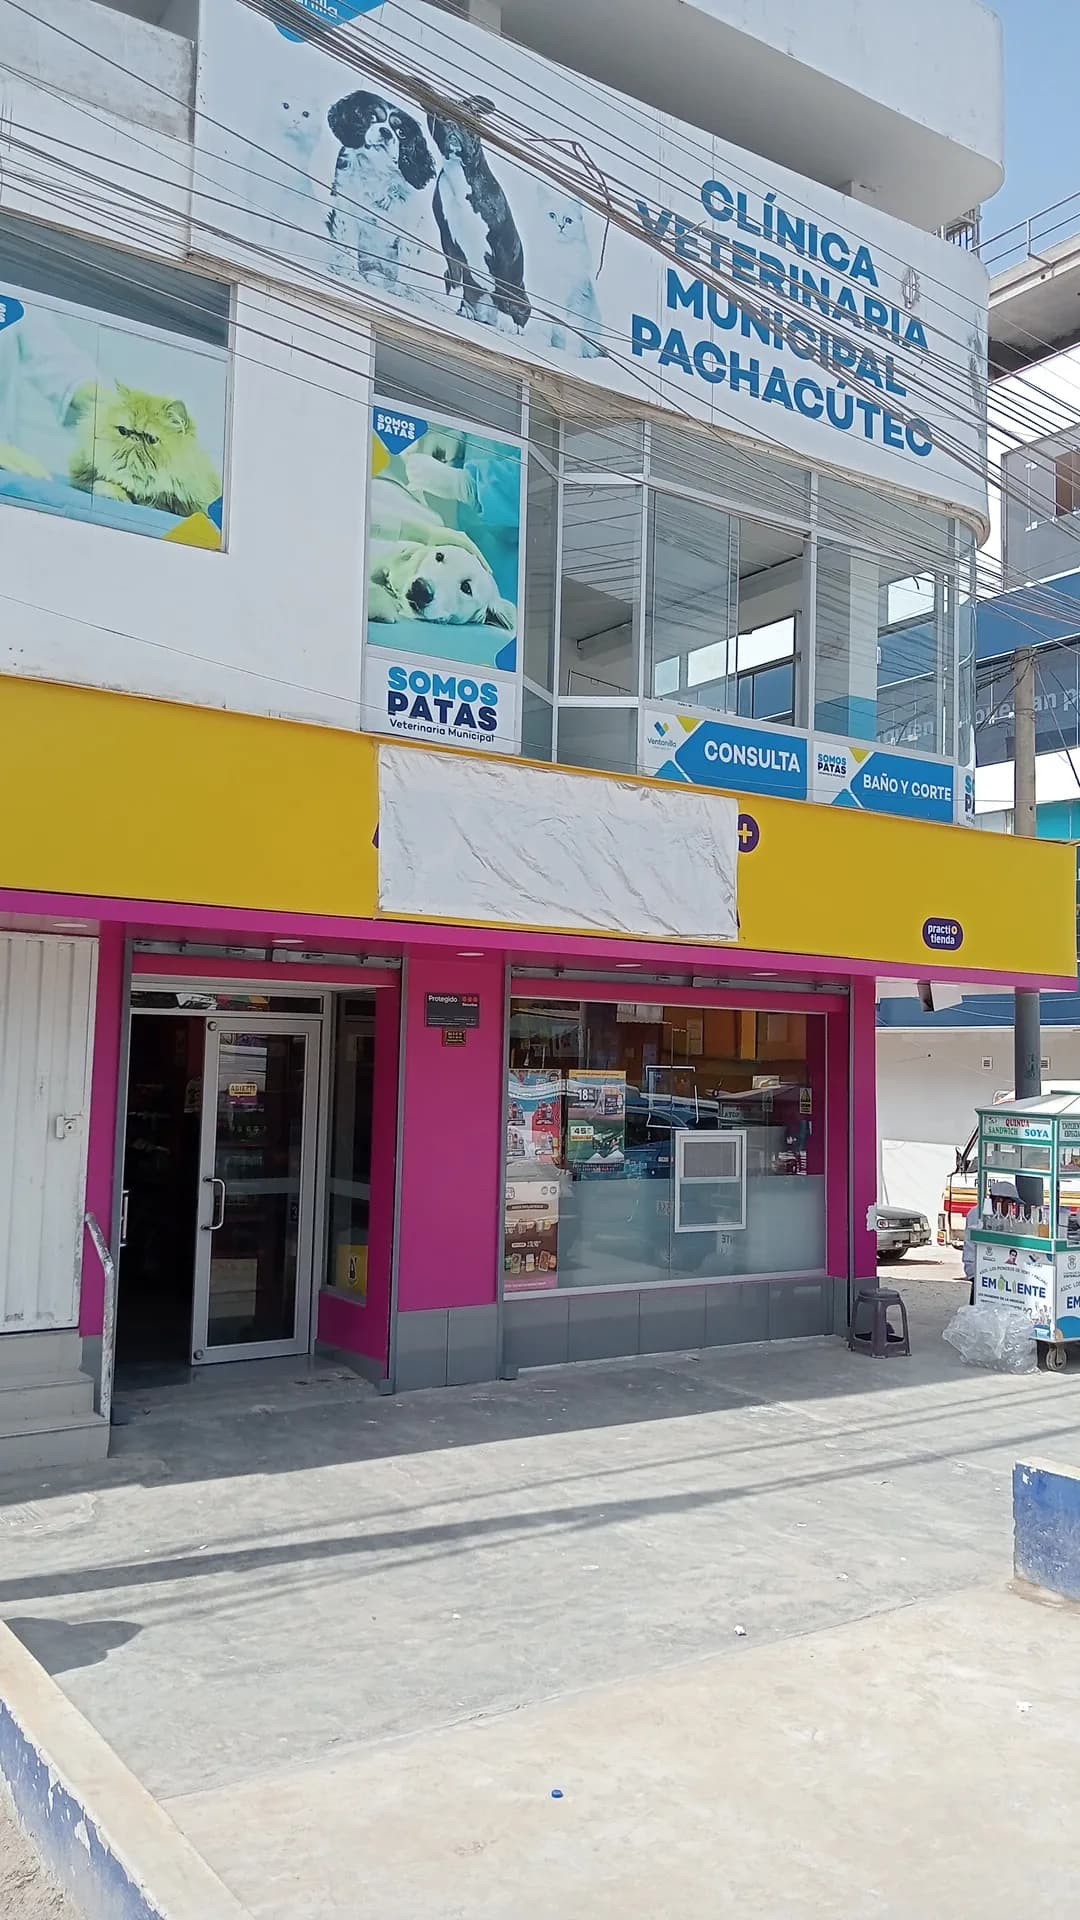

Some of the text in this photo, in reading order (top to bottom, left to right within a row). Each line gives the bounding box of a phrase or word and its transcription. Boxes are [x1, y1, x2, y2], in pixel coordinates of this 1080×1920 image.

[701, 179, 879, 288] CLÍNICA
[635, 199, 929, 351] VETERINARIA
[666, 269, 908, 397] MUNICIPAL
[632, 314, 933, 457] PACHACÚTEC
[377, 414, 416, 431] SOMOS
[377, 422, 415, 440] PATAS
[388, 666, 498, 707] SOMOS
[388, 691, 498, 731] PATAS
[389, 718, 495, 743] Veterinaria Municipal
[704, 740, 801, 773] CONSULTA
[817, 754, 847, 765] SOMOS
[817, 762, 847, 775] PATAS
[863, 773, 952, 802] BAÑO Y CORTE
[931, 934, 955, 945] tienda
[428, 995, 458, 1003] Protegido
[1024, 1129, 1049, 1138] SOYA
